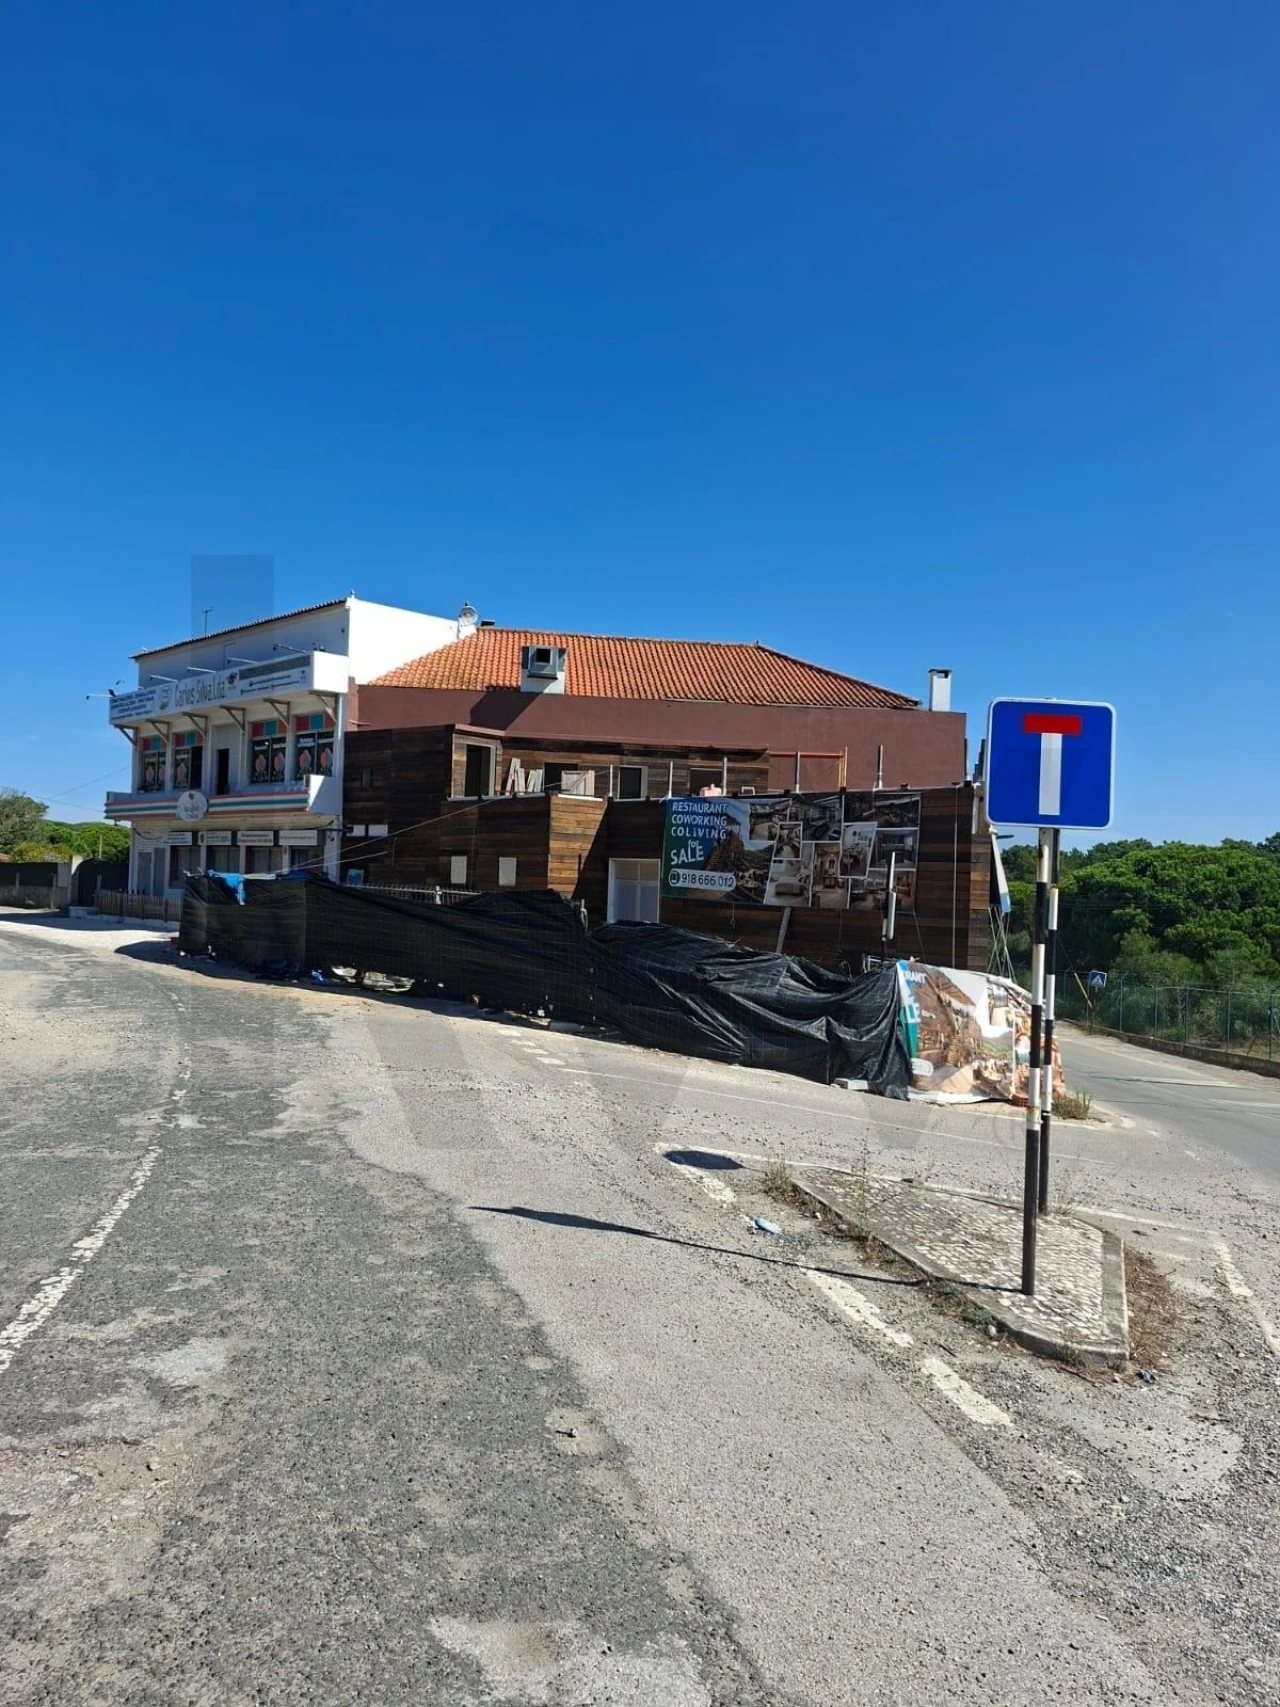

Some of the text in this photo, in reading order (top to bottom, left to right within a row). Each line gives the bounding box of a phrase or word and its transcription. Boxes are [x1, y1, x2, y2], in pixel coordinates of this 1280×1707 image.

[672, 802, 728, 813] RESTAURANT
[671, 814, 728, 827] COWORKING
[671, 826, 727, 839] COLIVING
[670, 845, 704, 865] SALE
[681, 873, 735, 888] 918 666 012
